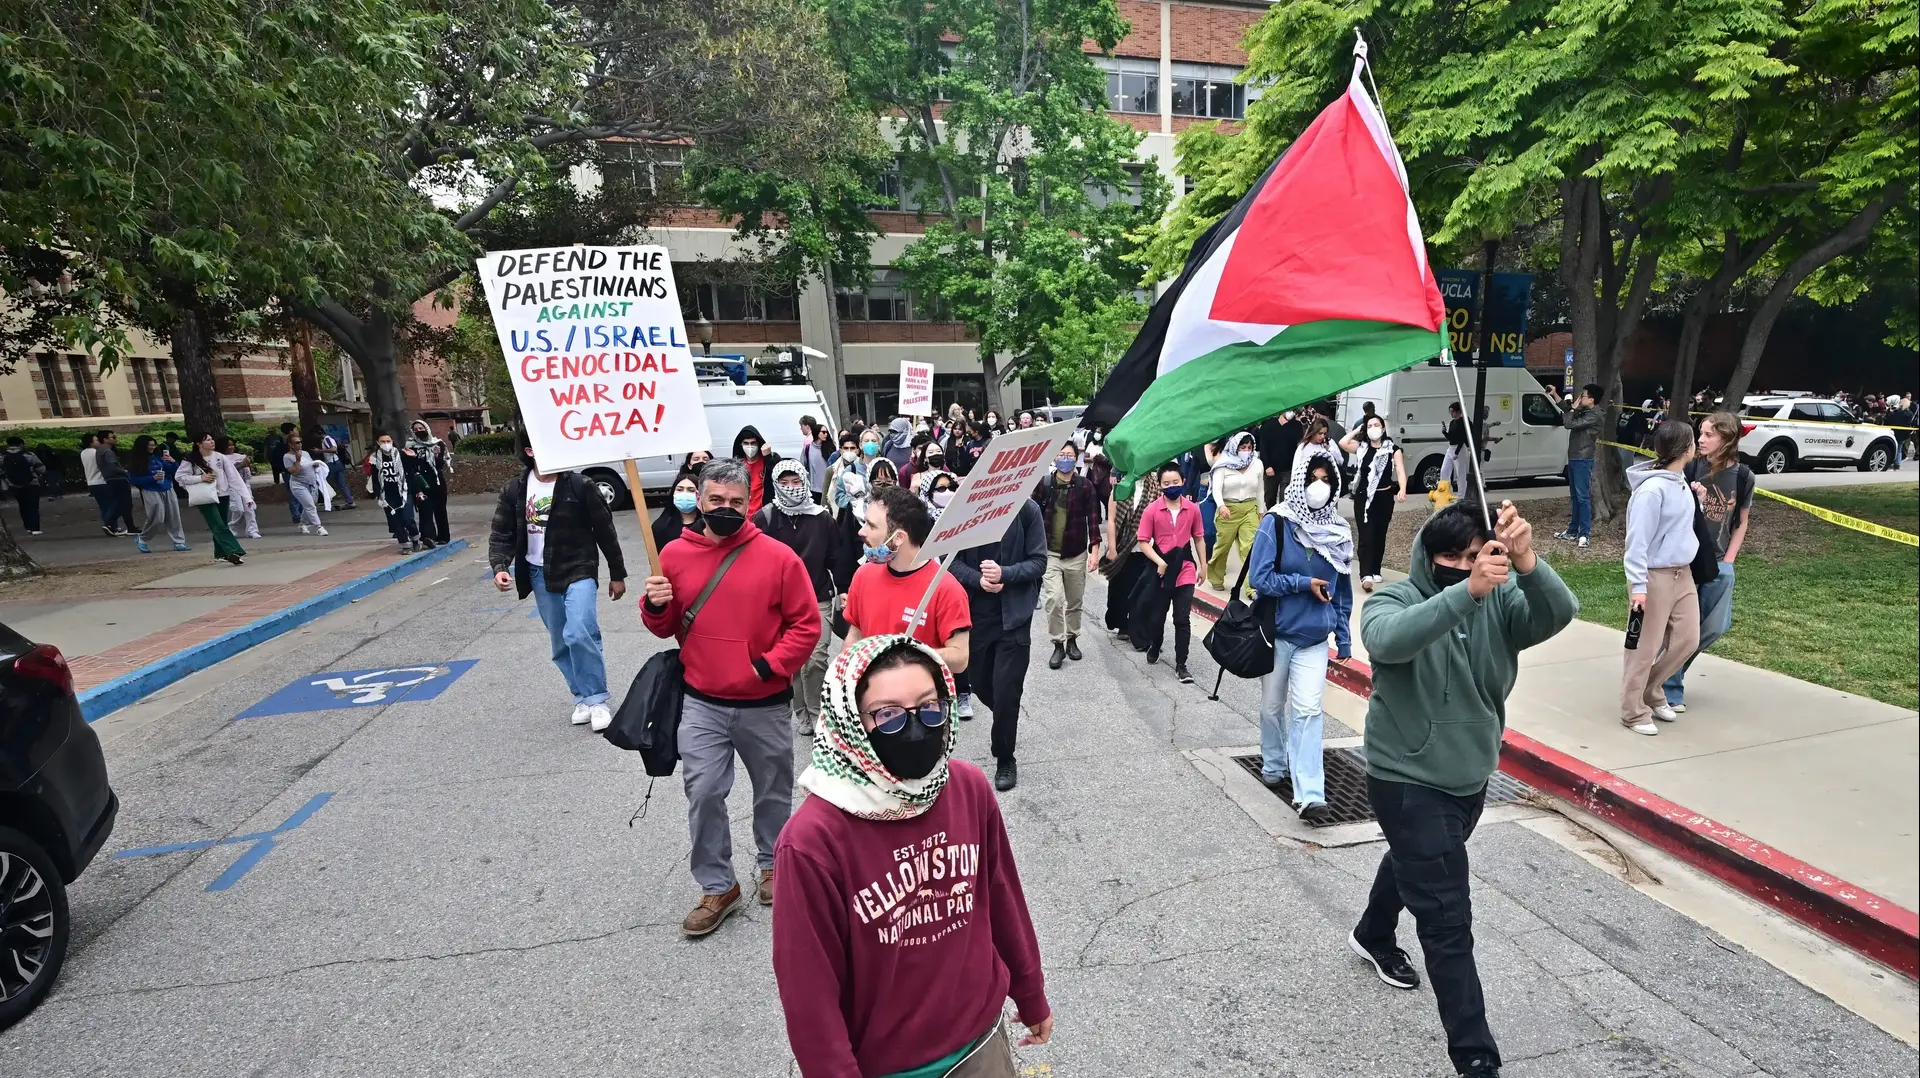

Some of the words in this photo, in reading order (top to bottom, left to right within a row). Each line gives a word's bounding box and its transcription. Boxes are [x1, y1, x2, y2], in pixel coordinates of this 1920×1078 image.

[497, 248, 607, 278] DEFEND
[617, 251, 663, 271] THE
[501, 275, 667, 311] PALESTINIANS
[1440, 283, 1472, 299] UCLA
[536, 301, 633, 323] AGAINST
[521, 352, 679, 383] GENOCIDAL
[907, 366, 928, 378] UAW
[550, 384, 614, 407] WAR
[622, 380, 656, 401] ON
[903, 396, 929, 405] PALESTINE
[560, 404, 665, 441] GAZA!
[988, 439, 1052, 475] UAW
[971, 475, 1004, 490] RANK
[1004, 473, 1013, 482] &
[1014, 466, 1037, 480] FILE
[966, 481, 1022, 504] WORKERS
[974, 500, 994, 514] FOR
[933, 501, 1015, 543] PALESTINE
[893, 845, 920, 861] EST.
[921, 832, 948, 850] 1872
[853, 844, 979, 924] YELLOWSTON
[878, 904, 943, 944] NATIONAL
[947, 893, 973, 917] PAR
[932, 919, 968, 943] APPAREL
